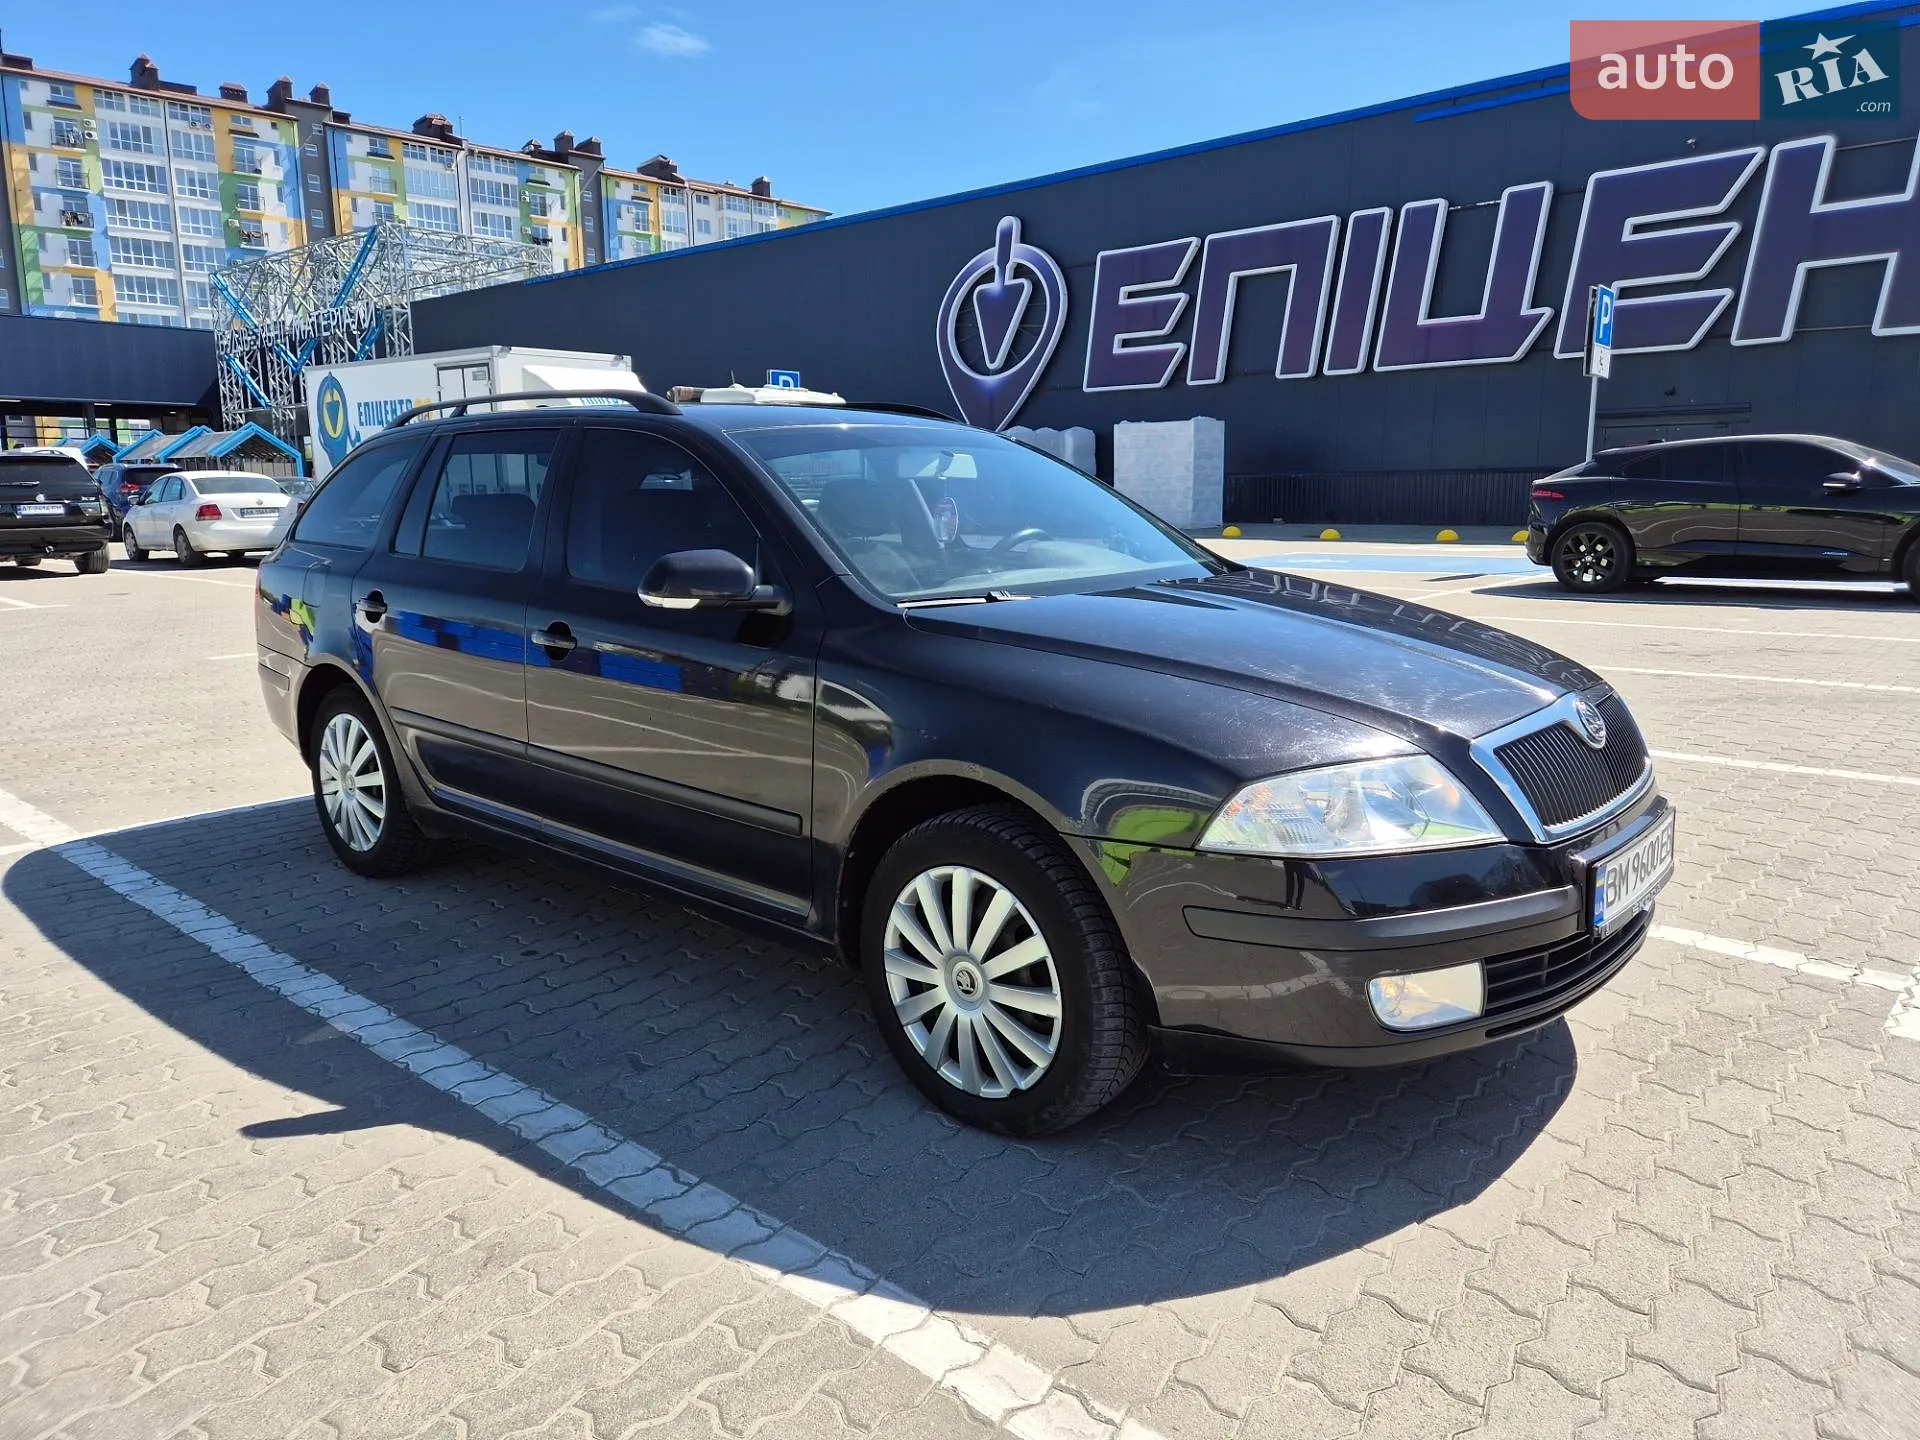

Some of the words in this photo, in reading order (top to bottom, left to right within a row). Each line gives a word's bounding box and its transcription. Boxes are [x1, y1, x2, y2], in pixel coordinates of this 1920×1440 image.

[1599, 294, 1611, 339] P
[1606, 857, 1630, 908] BM
[1632, 835, 1660, 890] 9600
